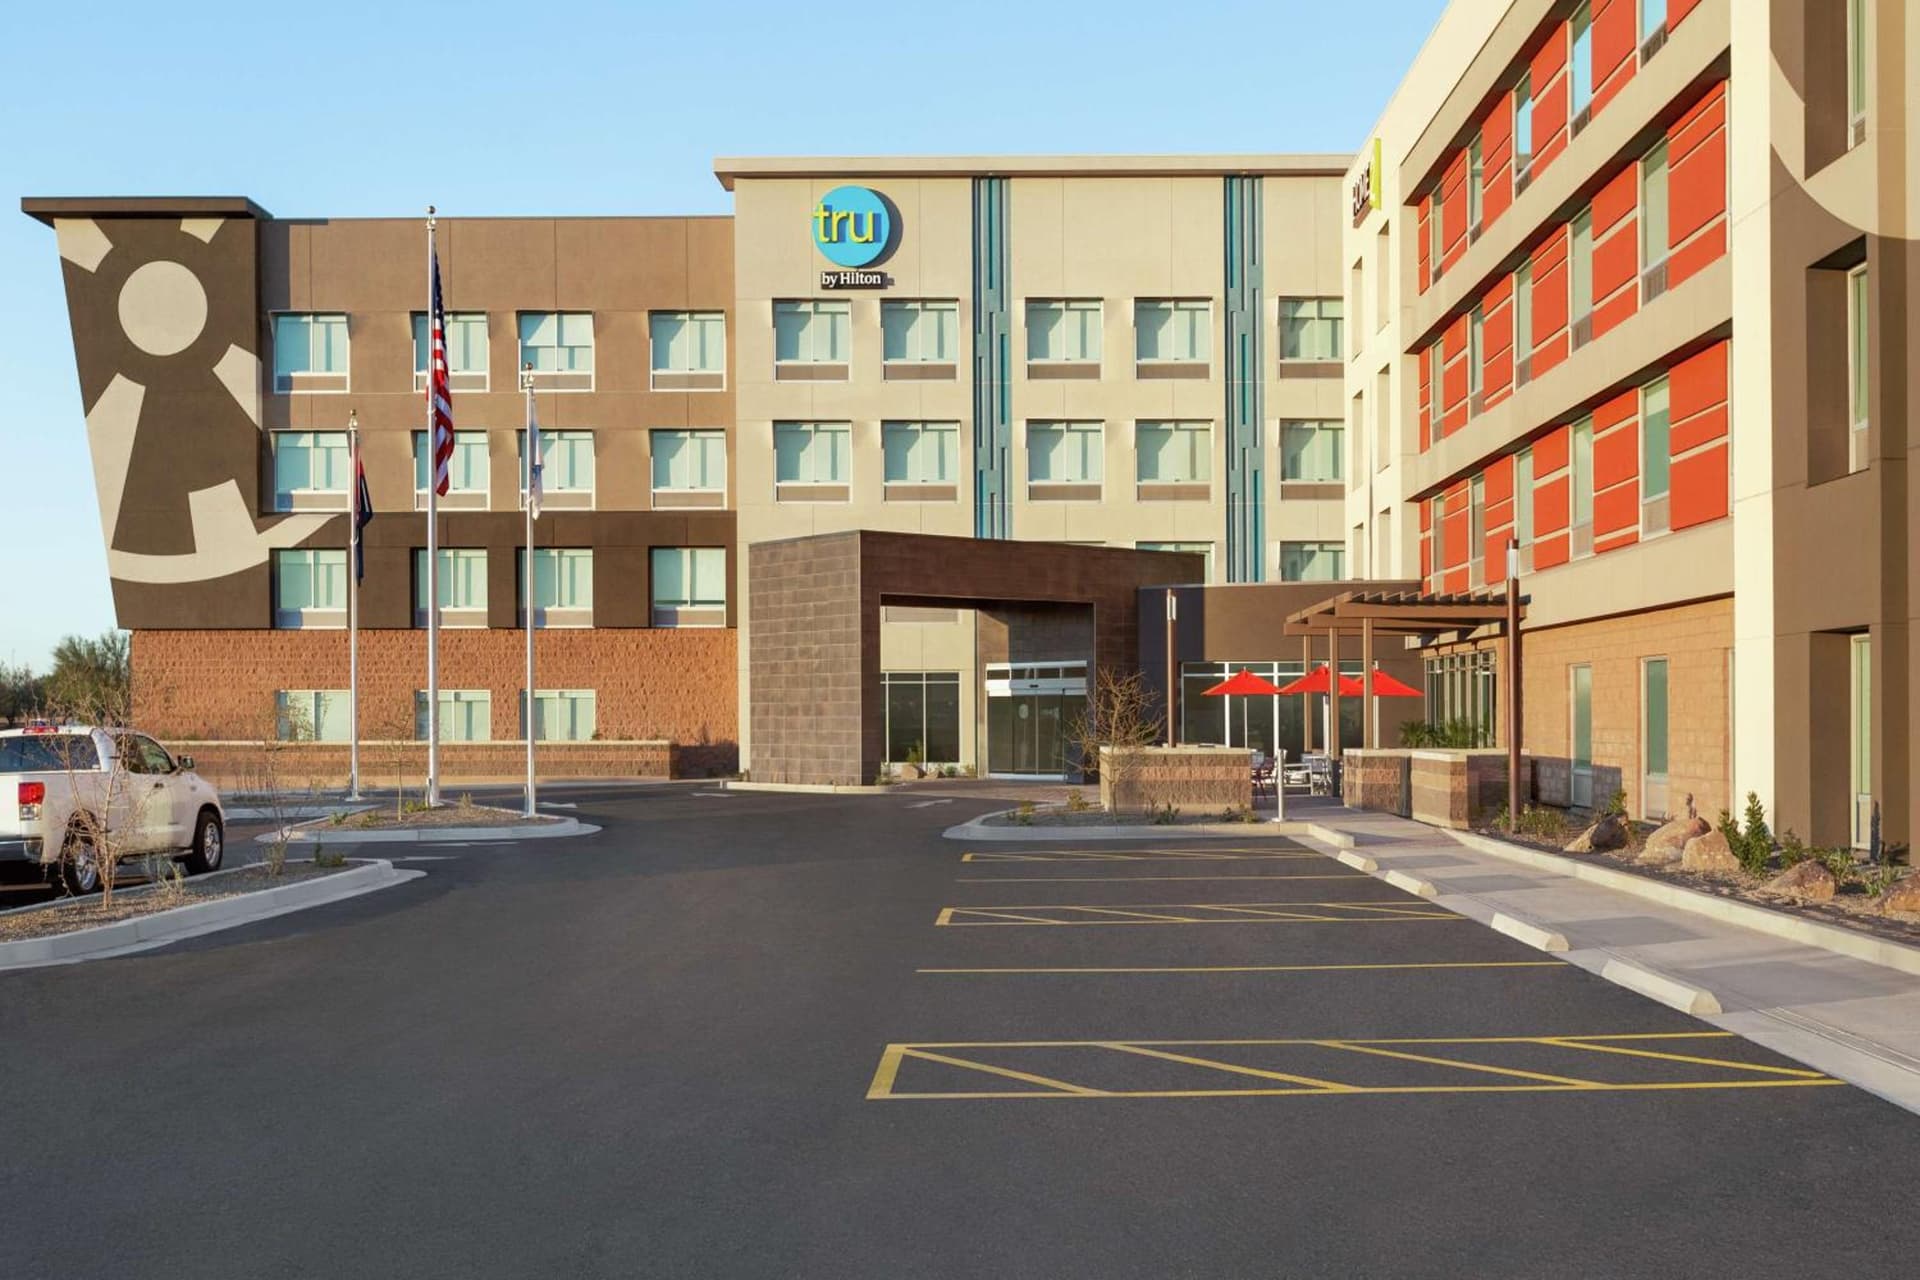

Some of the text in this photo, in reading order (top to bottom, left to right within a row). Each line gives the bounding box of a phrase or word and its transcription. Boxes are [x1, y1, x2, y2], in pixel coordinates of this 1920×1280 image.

[811, 202, 874, 243] tru
[822, 272, 881, 288] by Hilton
